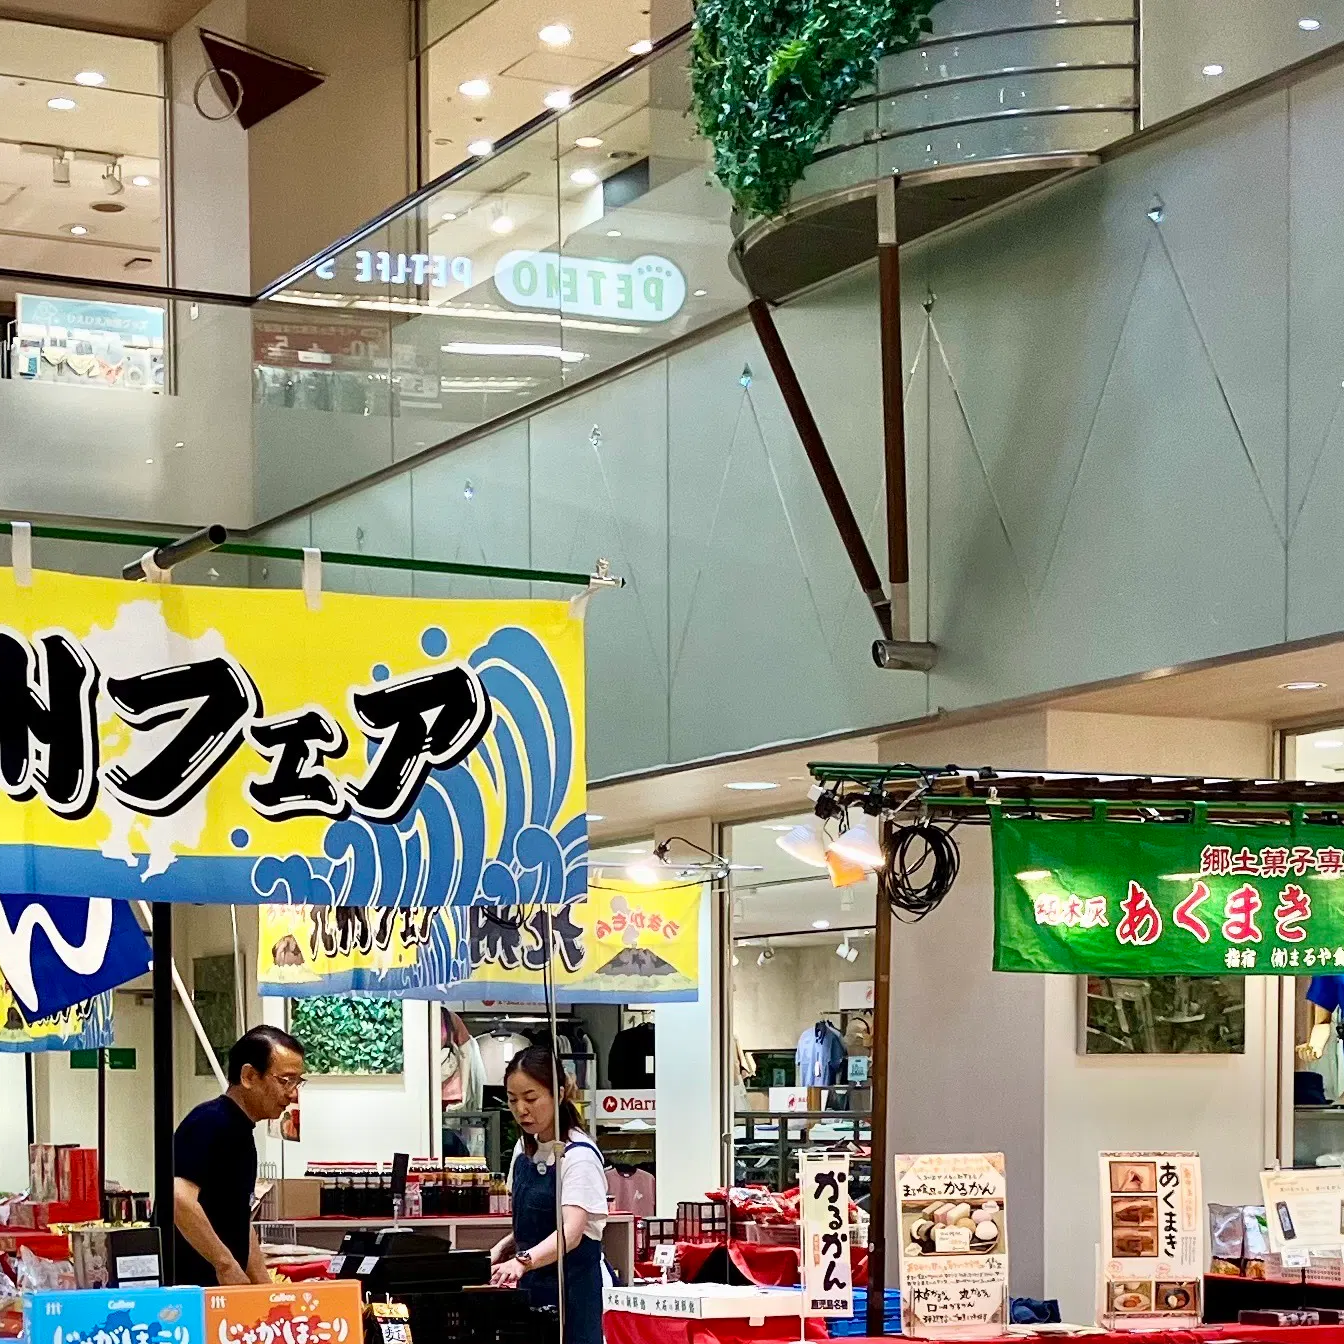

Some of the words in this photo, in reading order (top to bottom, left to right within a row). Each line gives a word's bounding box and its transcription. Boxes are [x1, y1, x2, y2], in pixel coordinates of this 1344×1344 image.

[1117, 880, 1311, 945] あくまき
[813, 1170, 847, 1293] かるかん
[1158, 1161, 1180, 1258] あくまき
